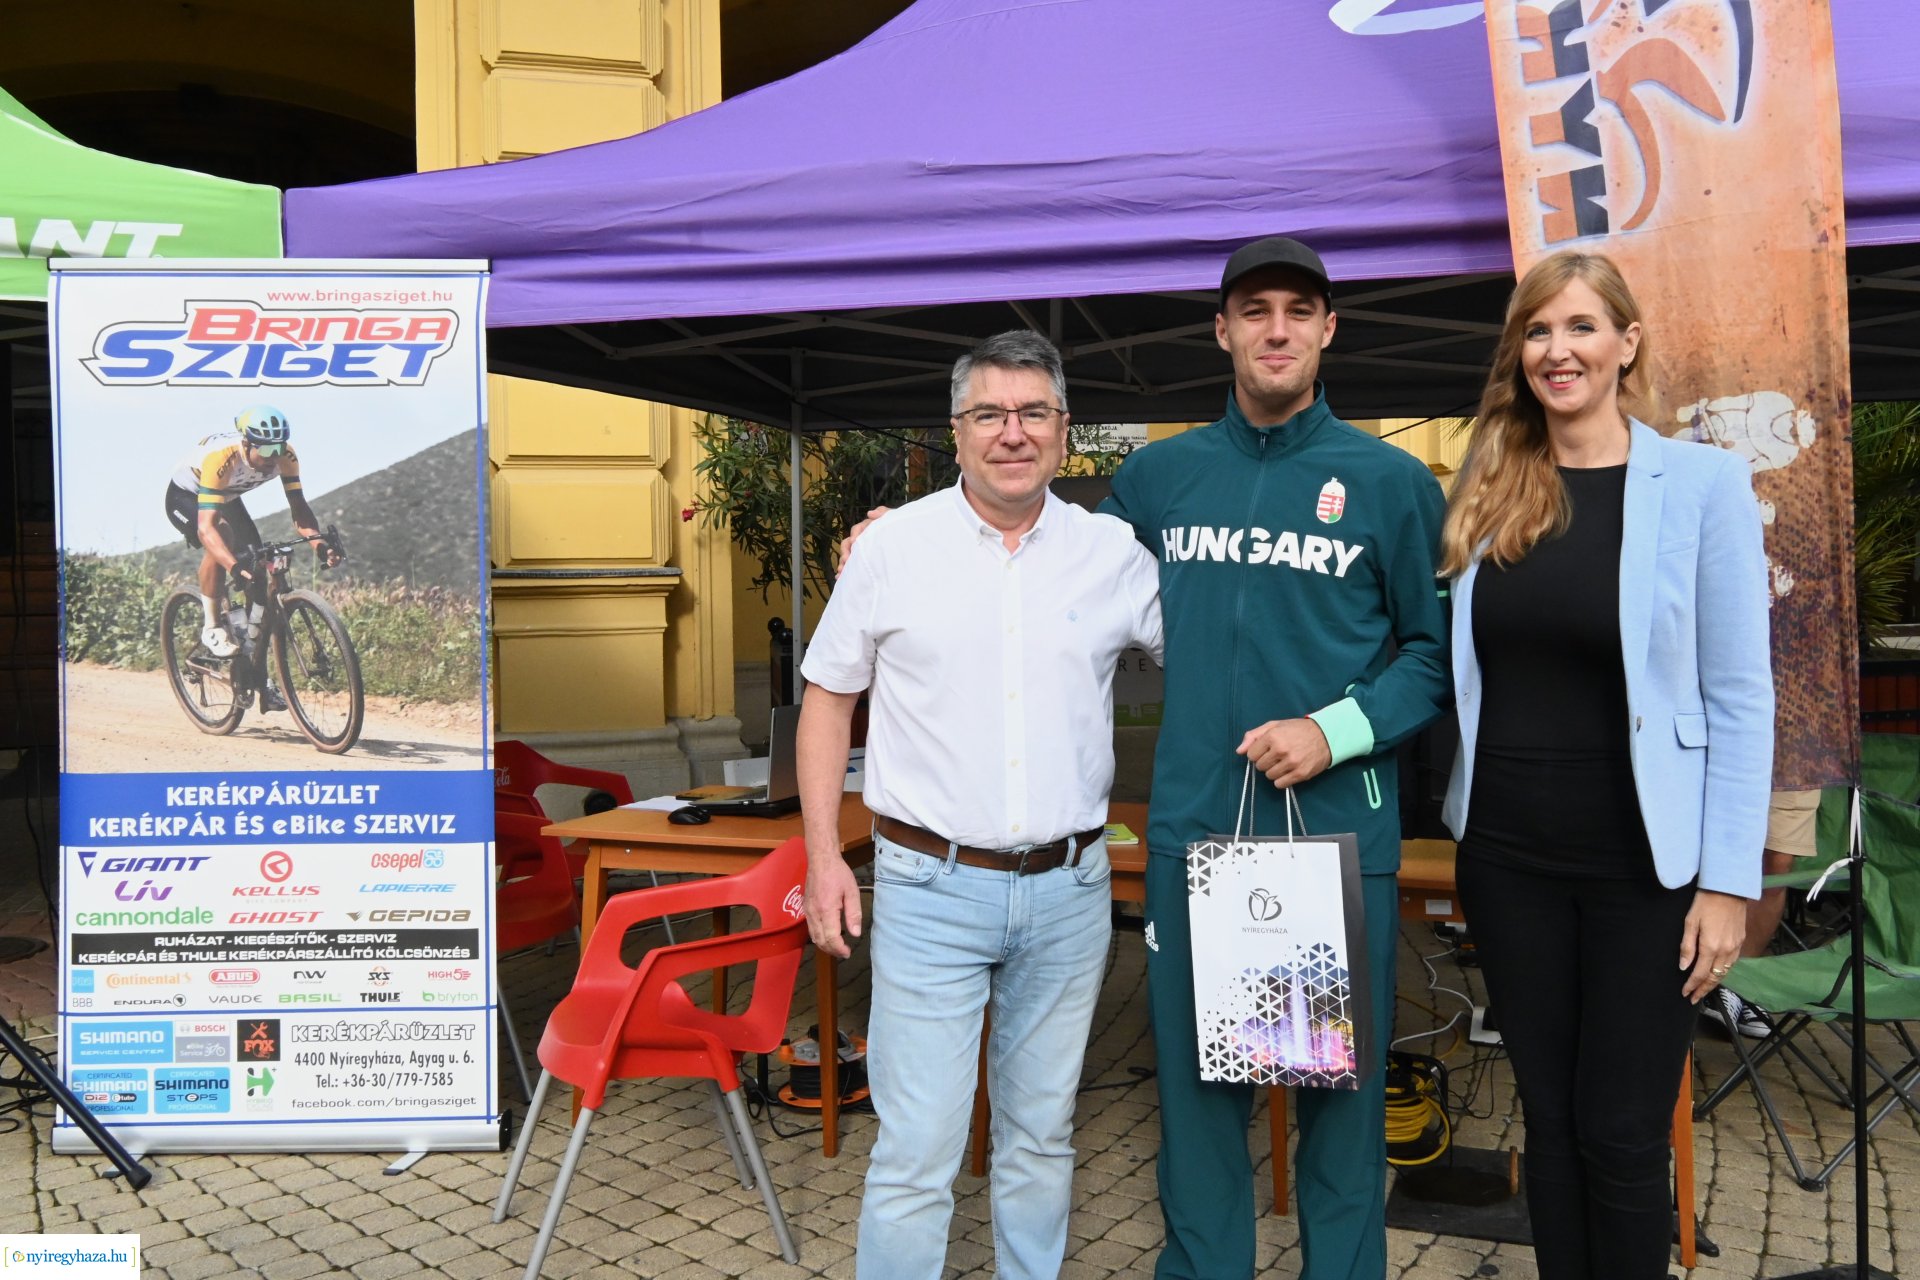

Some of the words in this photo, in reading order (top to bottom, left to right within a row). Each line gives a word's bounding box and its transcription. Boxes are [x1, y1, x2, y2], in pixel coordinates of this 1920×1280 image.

[267, 288, 454, 307] www.bringasziget.hu
[187, 308, 452, 347] BRINGA
[98, 330, 445, 379] SZIGET
[1161, 526, 1365, 578] HUNGARY
[166, 780, 380, 807] KERÉKPÁRÜZLET
[89, 811, 227, 838] KERÉKPÁR
[234, 811, 265, 836] ÉS
[272, 814, 346, 835] eBike
[353, 814, 456, 835] SZERVIZ
[100, 856, 213, 873] GIANT
[371, 849, 424, 873] csepel
[114, 879, 174, 902] Liv
[359, 883, 457, 893] LAPIERRE
[76, 906, 214, 927] cannondale
[228, 911, 325, 924] GHOST
[368, 909, 472, 923] GEPIDA
[154, 933, 226, 947] RUHÁZAT
[234, 931, 330, 946] KIEGÉSZÍTŐK
[337, 933, 398, 945] SZERVIZ
[78, 950, 157, 964] KERÉKPÁR
[158, 949, 178, 963] ÉS
[179, 950, 227, 962] THULE
[228, 946, 375, 961] KERÉKPÁRSZÁLLÍTÓ
[375, 946, 471, 960] KÖLCSÖNZÉS
[106, 972, 181, 989] Continental
[215, 970, 254, 982] ABUS
[208, 994, 264, 1004] VAUDE
[278, 992, 341, 1003] BASIL
[360, 991, 401, 1003] THULE
[438, 991, 479, 1004] bryton
[194, 1024, 226, 1033] BOSCH
[291, 1020, 476, 1043] KERÉKPÁRÜZLET
[80, 1030, 165, 1045] SHIMANO
[243, 1039, 275, 1053] FOX
[294, 1052, 326, 1067] 4400
[329, 1050, 406, 1070] Nyíregyháza,
[409, 1050, 446, 1069] Agyag
[448, 1053, 459, 1064] u.
[463, 1050, 475, 1064] 6.
[73, 1080, 148, 1092] SHIMANO
[154, 1078, 229, 1091] SHIMANO
[315, 1073, 340, 1089] Tel.:
[342, 1071, 454, 1090] +36-30/779-7585
[291, 1096, 477, 1109] facebook.com/bringasziget
